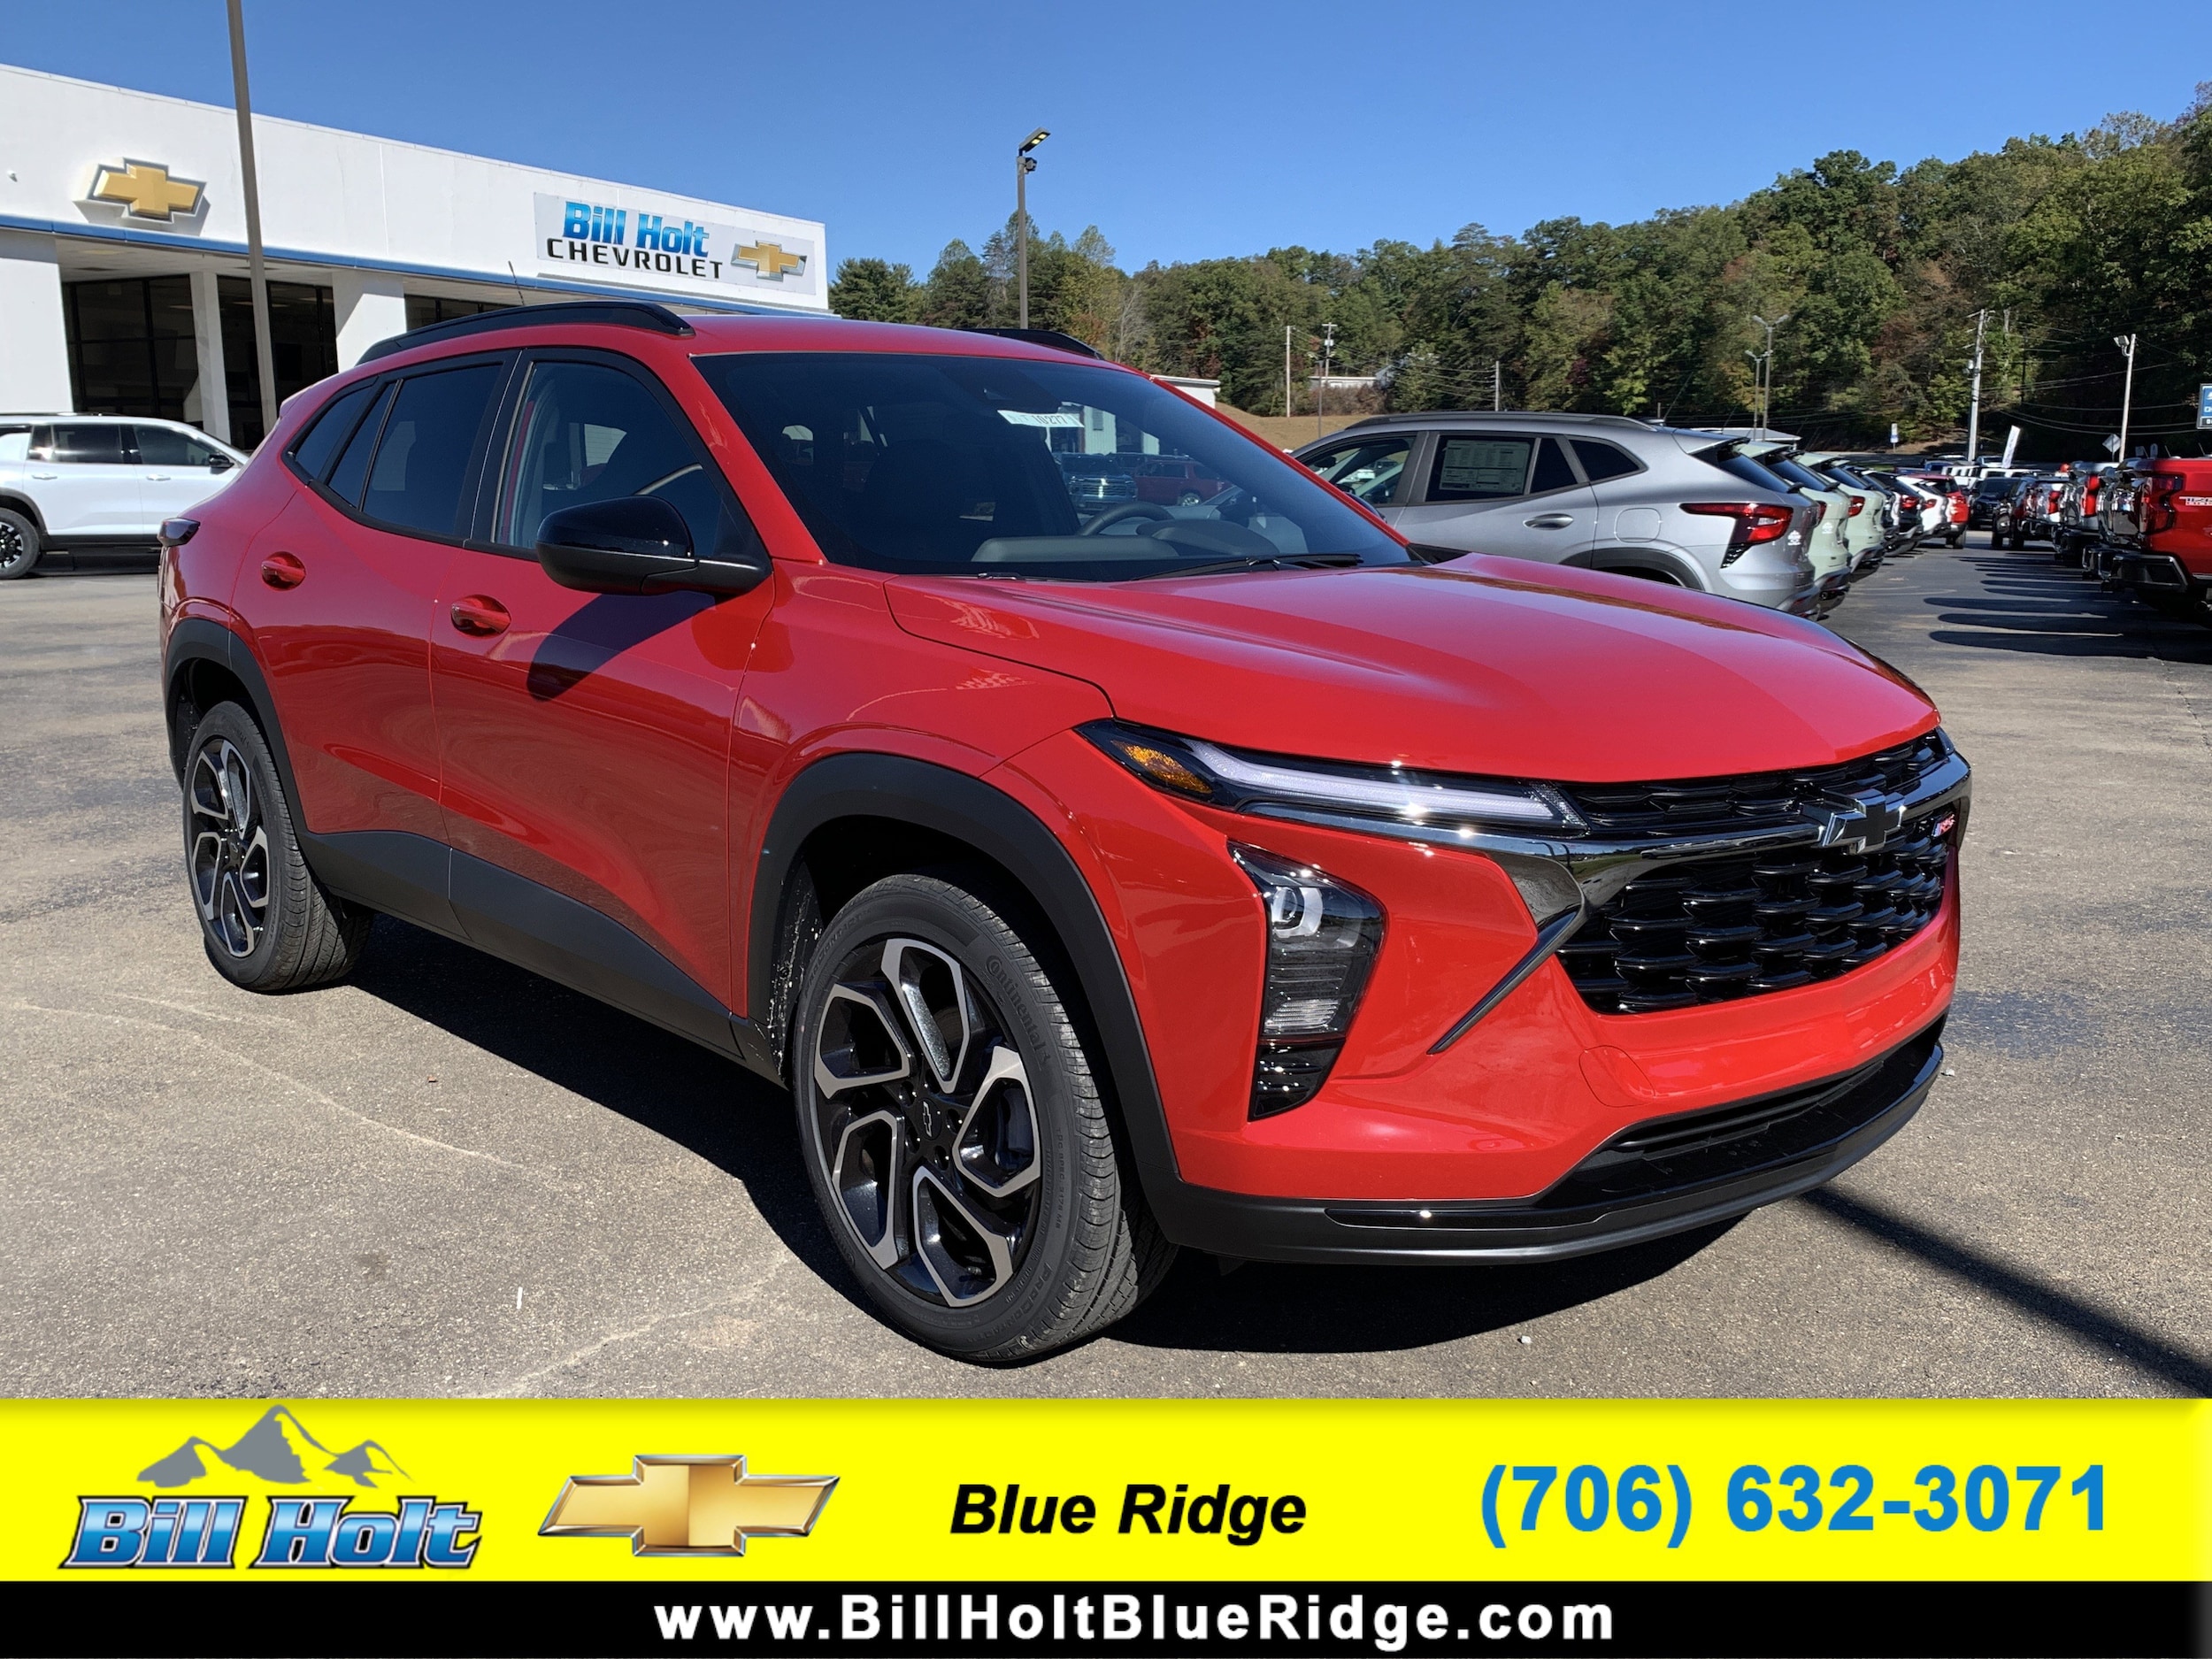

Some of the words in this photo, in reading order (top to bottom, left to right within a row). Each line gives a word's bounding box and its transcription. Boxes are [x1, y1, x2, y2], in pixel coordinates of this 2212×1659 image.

[562, 200, 626, 245] Bill
[635, 213, 710, 257] Holt
[547, 237, 723, 279] CHEVROLET
[985, 954, 1048, 1051] Continental
